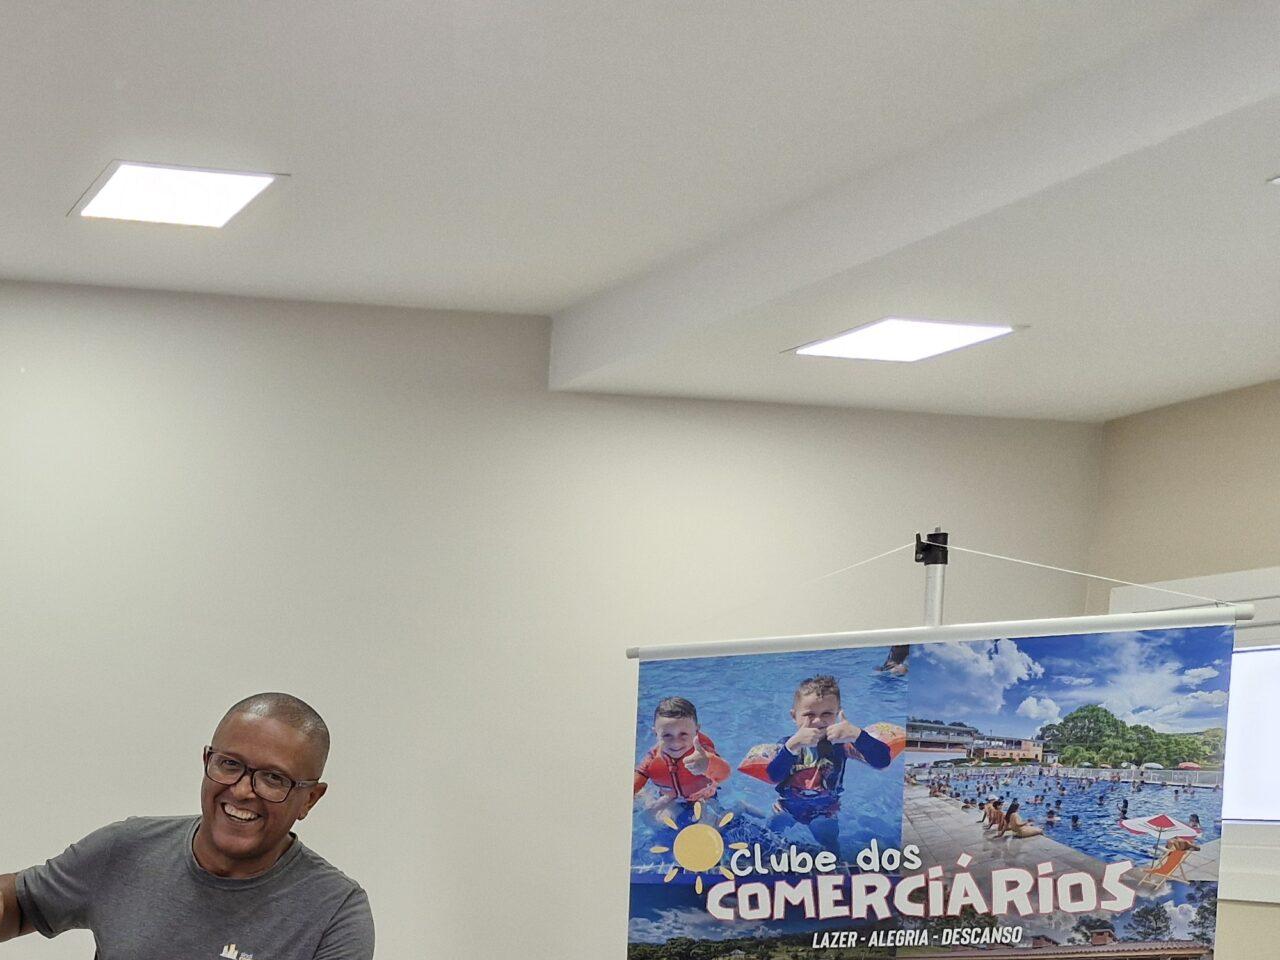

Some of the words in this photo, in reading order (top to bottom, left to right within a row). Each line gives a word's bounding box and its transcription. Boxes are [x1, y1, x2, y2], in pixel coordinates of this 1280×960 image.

[730, 843, 837, 876] Clube
[856, 838, 922, 872] dos
[706, 853, 1136, 921] COMERCIÁRIOS
[812, 931, 857, 949] LAZER
[868, 929, 929, 947] ALEGRIA
[941, 926, 1023, 945] DESCANSO
